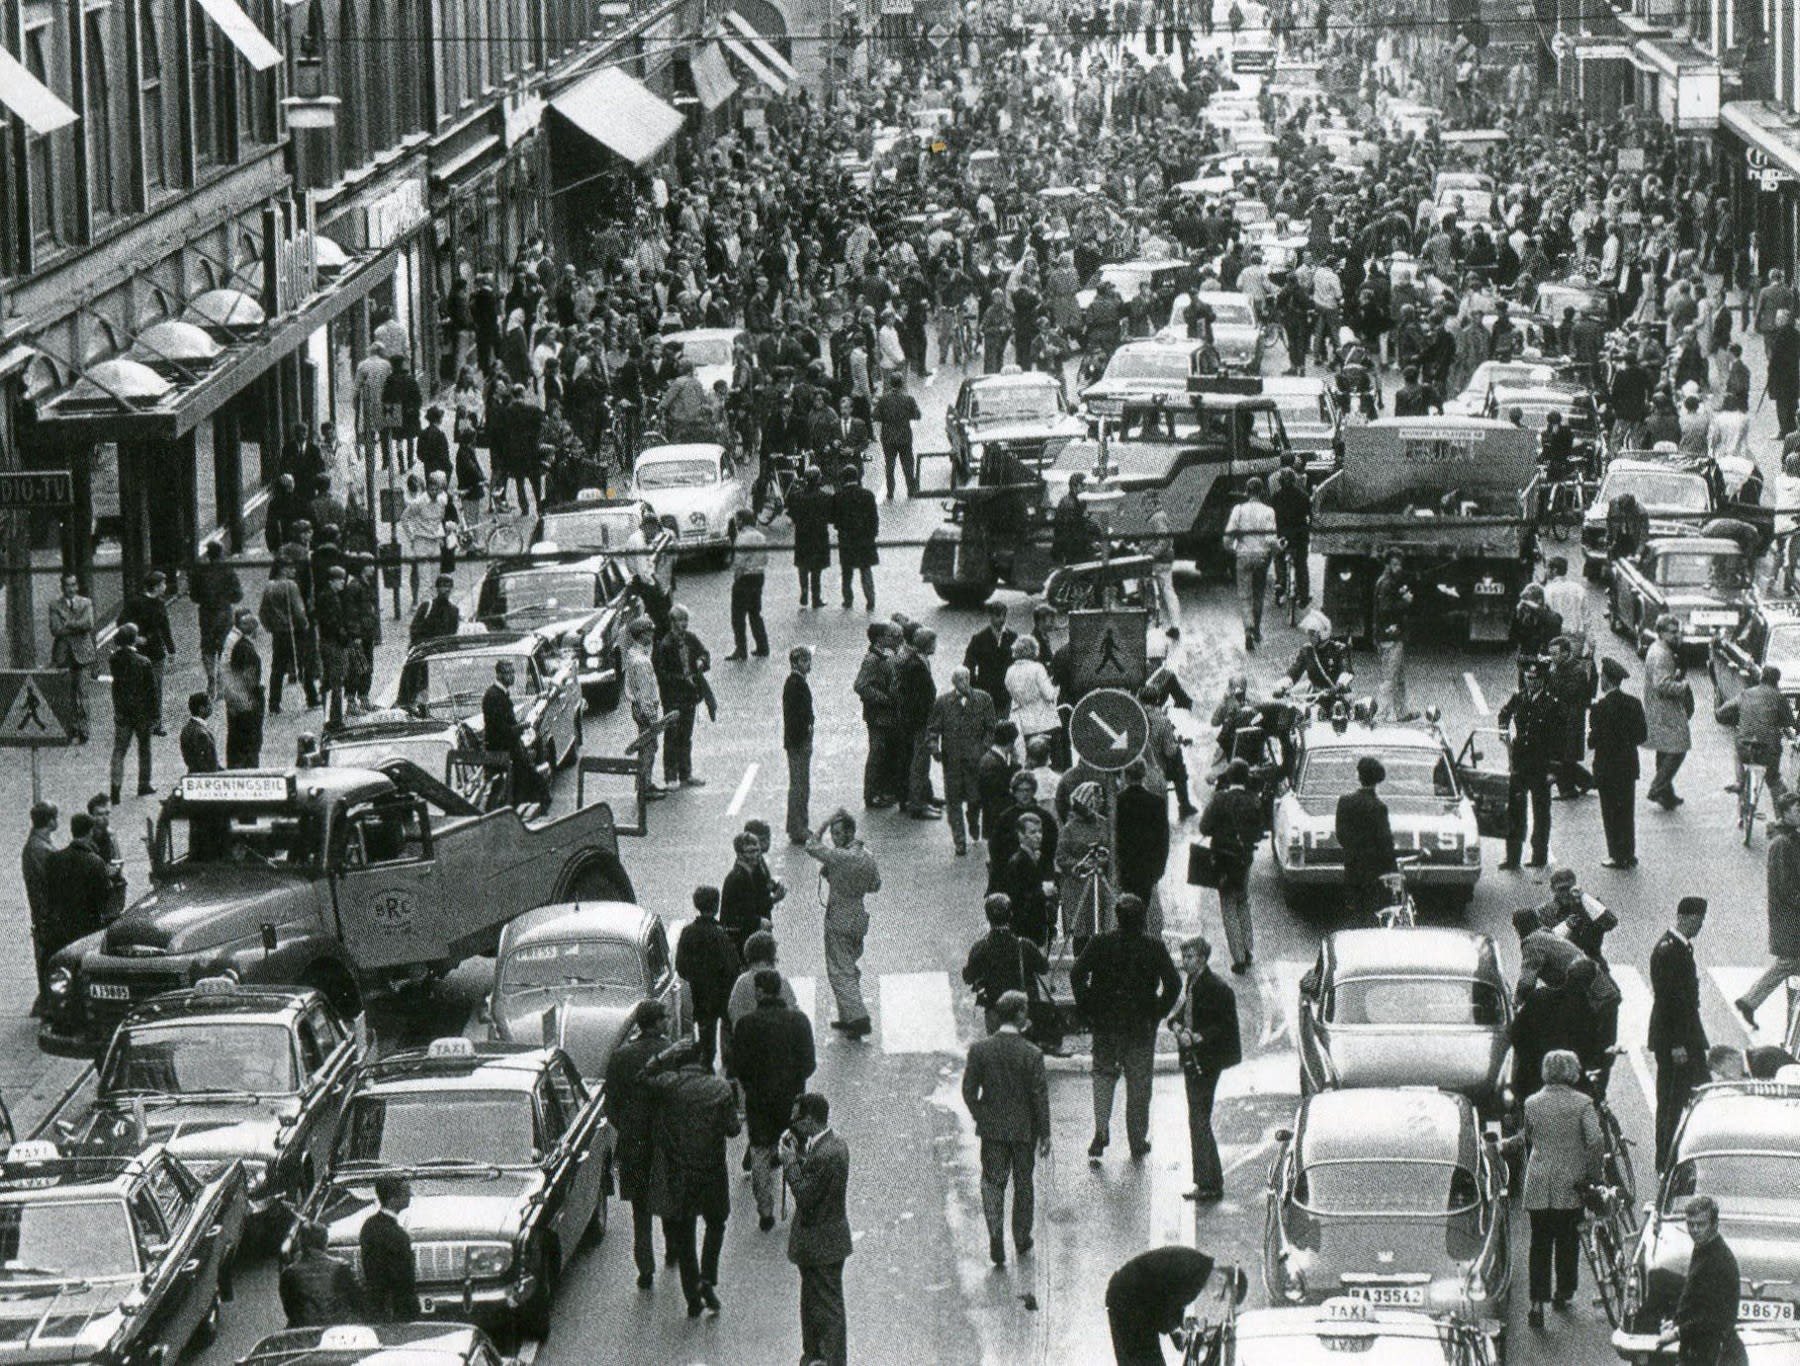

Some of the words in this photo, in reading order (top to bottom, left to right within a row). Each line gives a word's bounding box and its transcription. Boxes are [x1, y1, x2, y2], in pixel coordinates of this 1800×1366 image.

[434, 1044, 465, 1055] TAXI
[16, 1147, 47, 1158] TAXI
[1330, 1305, 1367, 1317] TAXI
